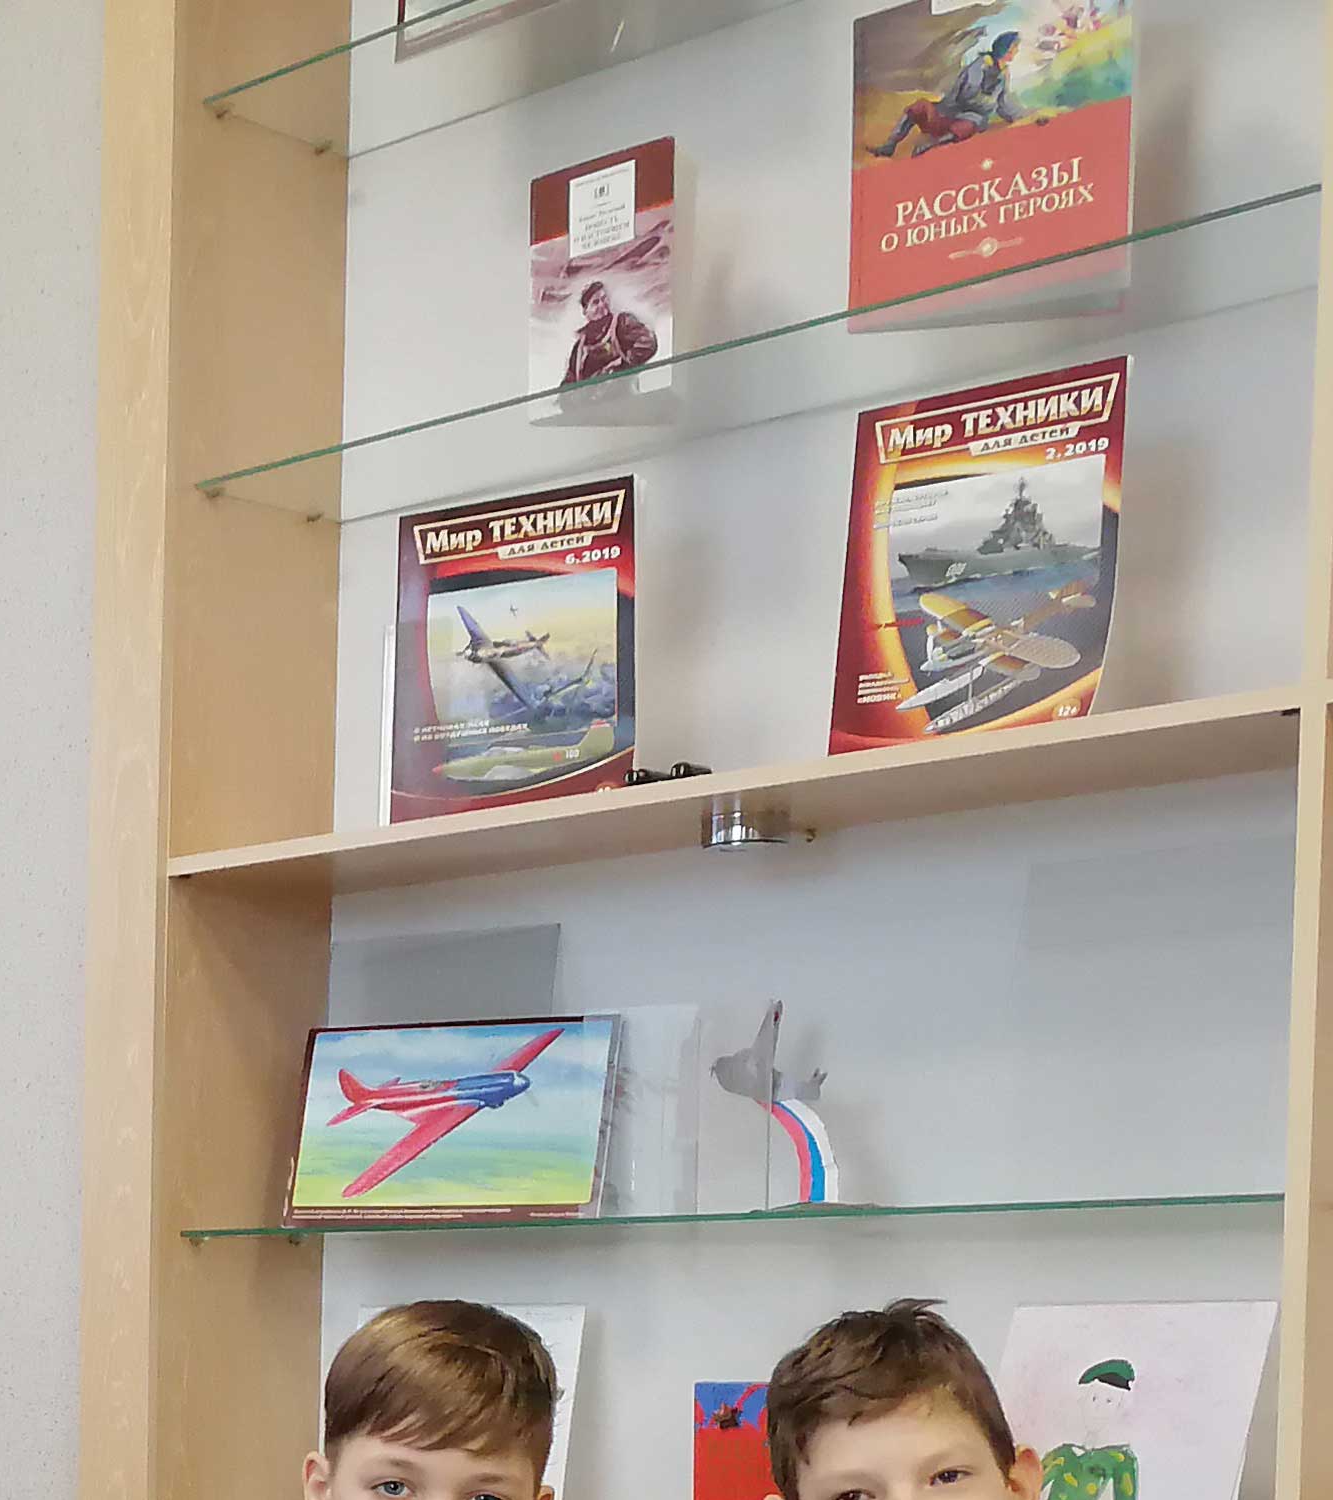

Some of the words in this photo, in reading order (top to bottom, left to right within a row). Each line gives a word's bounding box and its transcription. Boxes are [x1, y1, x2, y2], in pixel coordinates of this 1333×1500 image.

[880, 232, 898, 252] О
[905, 210, 988, 248] ЮНЫХ
[998, 183, 1095, 224] ГЕРОЯХ
[895, 156, 1083, 228] РАССКАЗЫ
[888, 423, 953, 454] Мир
[961, 386, 1104, 438] ТЕХНИКИ
[1046, 437, 1109, 460] 2.2019
[425, 528, 483, 555] Мир
[489, 500, 612, 543] ТЕХНИКИ
[565, 545, 621, 565] 6.2019
